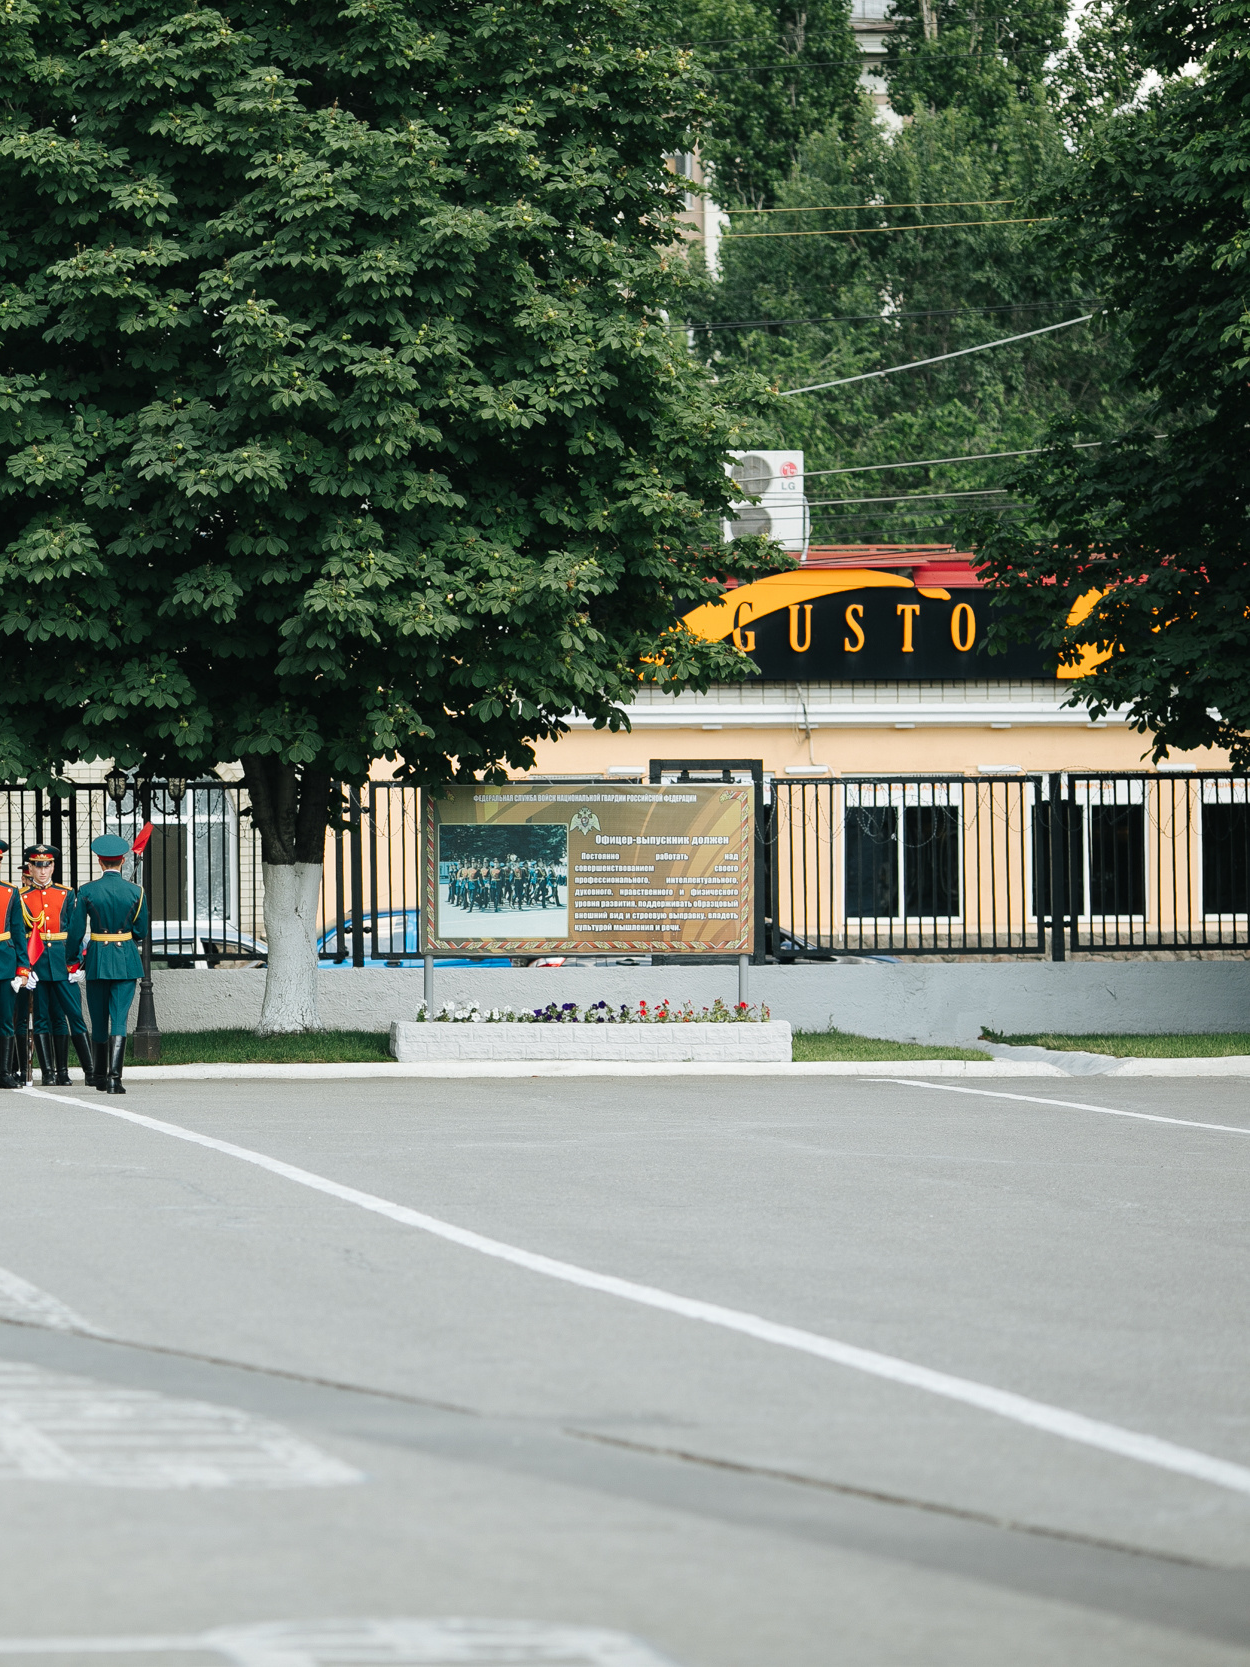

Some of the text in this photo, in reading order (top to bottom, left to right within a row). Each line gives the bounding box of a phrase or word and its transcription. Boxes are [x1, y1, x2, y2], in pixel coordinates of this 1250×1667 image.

[782, 482, 795, 490] LG
[732, 602, 976, 652] GUSTO
[514, 794, 537, 802] СЛУЖБА
[538, 794, 556, 802] ВОЙСК
[557, 794, 600, 802] НАЦИОНАЛЬНОЙ
[601, 794, 626, 802] ГВАРДИИ
[627, 794, 663, 802] РОССИЙСКОЙ
[664, 794, 697, 803] ФЕДЕРАЦИИ
[595, 834, 729, 845] Офицер-выпускник должен
[581, 852, 738, 861] Постоянно работать над
[574, 888, 613, 896] духовного,
[690, 888, 738, 896] физического
[693, 900, 738, 908] образцовый
[574, 911, 608, 919] внешний
[609, 912, 624, 920] вид
[632, 912, 667, 920] строевую
[668, 912, 706, 920] выправку,
[707, 912, 738, 920] владеть
[574, 923, 612, 932] культурой
[661, 924, 681, 932] речи.
